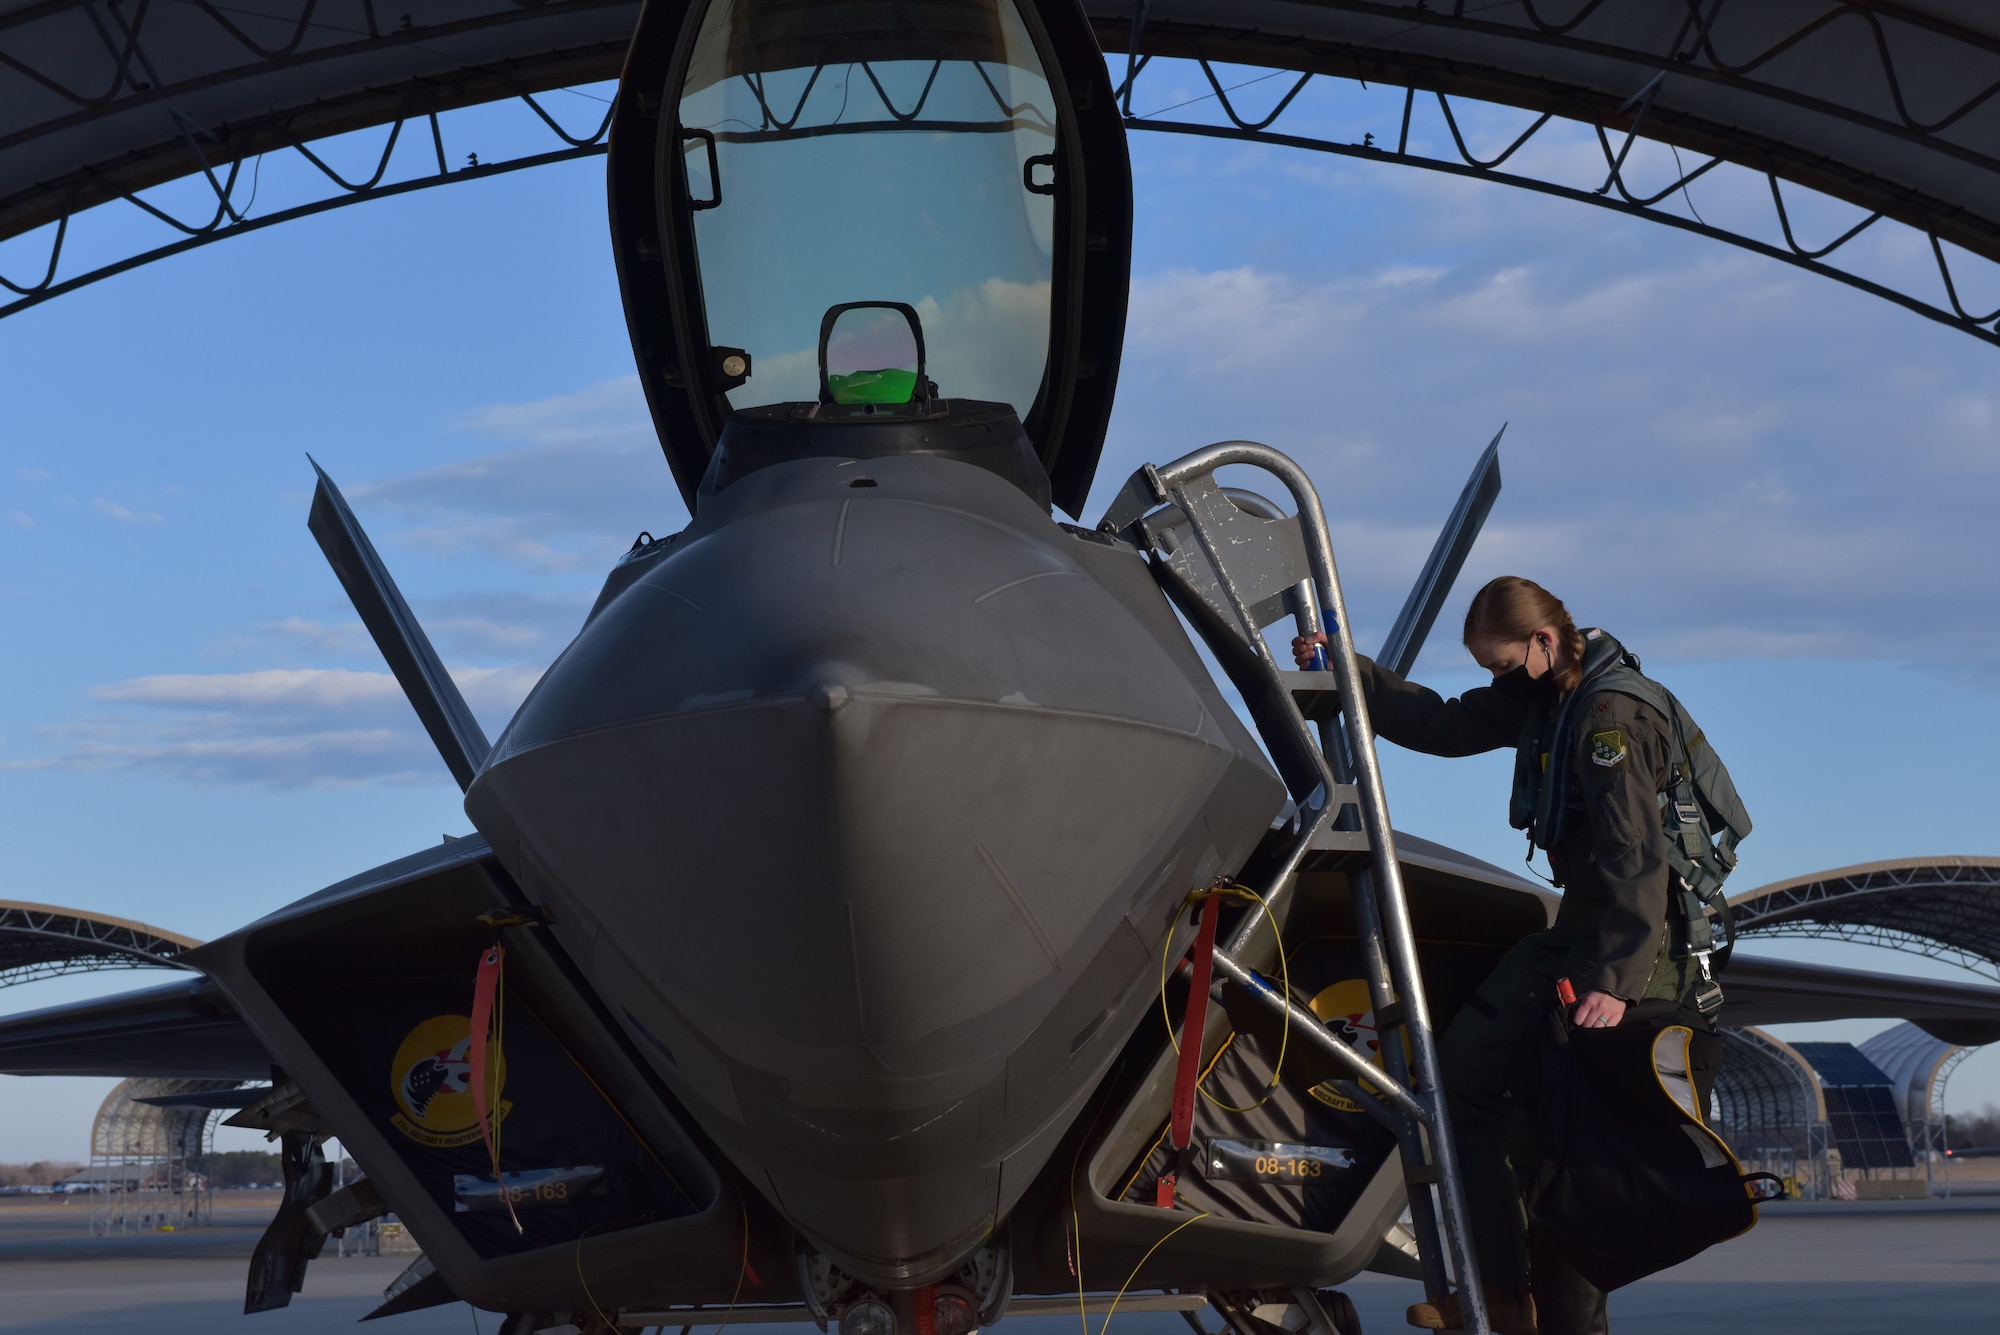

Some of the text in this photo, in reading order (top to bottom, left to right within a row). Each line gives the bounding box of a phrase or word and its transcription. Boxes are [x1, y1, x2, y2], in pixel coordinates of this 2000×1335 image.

[1312, 1087, 1345, 1108] AIRCRAFT
[409, 1129, 443, 1145] AIRCRAFT
[1255, 1157, 1322, 1177] 08-163
[498, 1182, 567, 1203] 08-163
